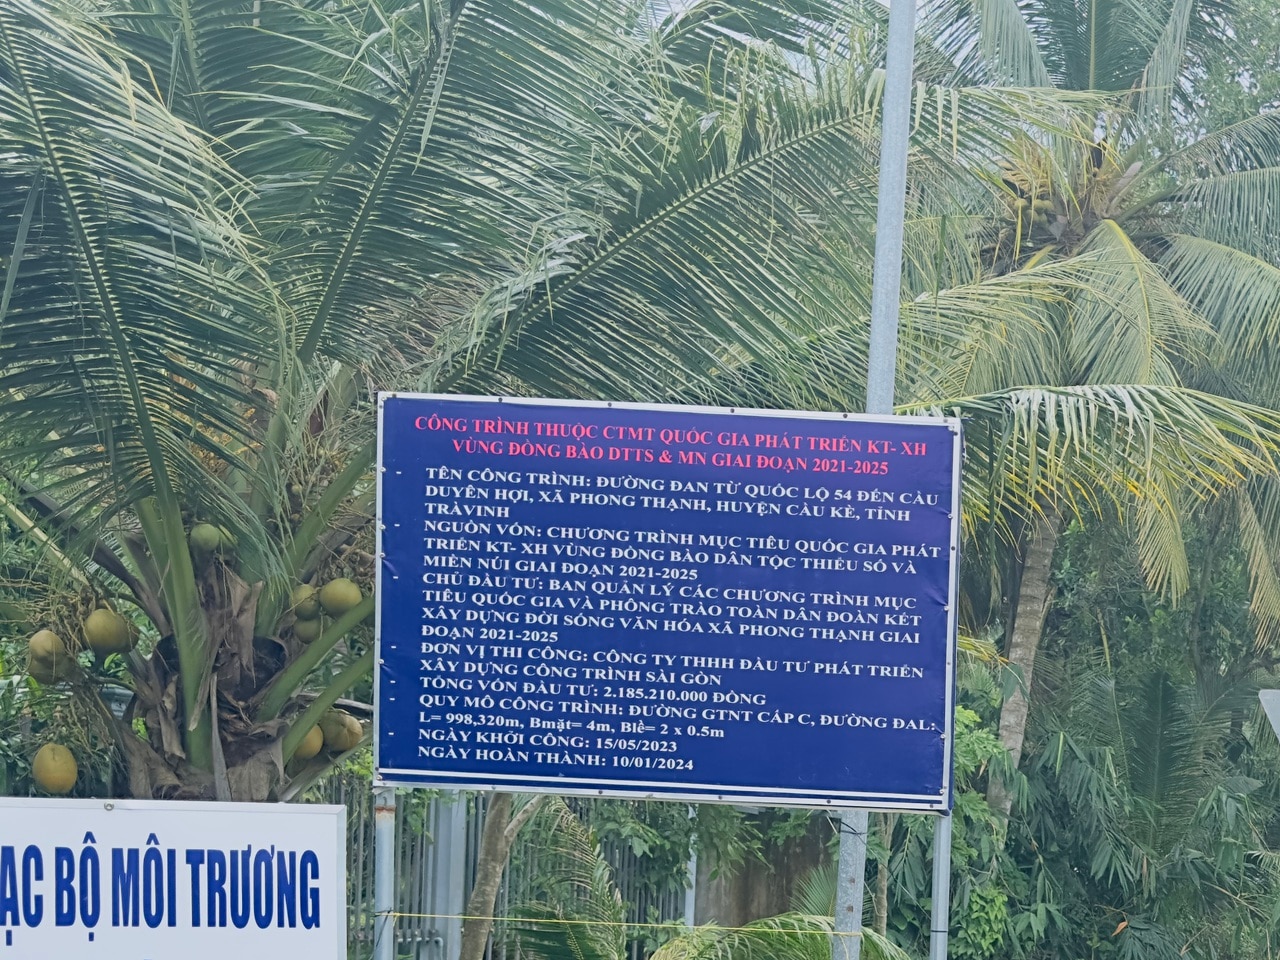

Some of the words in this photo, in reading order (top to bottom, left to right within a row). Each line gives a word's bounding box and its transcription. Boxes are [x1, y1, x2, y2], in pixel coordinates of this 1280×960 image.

[414, 413, 467, 431] CÔNG
[471, 416, 528, 434] TRÌNH
[533, 422, 597, 440] THUỘC
[602, 425, 655, 440] CTMT
[717, 432, 749, 446] GIA
[755, 431, 802, 449] PHÁT
[867, 439, 896, 453] KT-
[901, 441, 926, 455] XH
[452, 436, 502, 454] VÙNG
[565, 442, 603, 459] BÀO
[608, 446, 653, 462] DTTS
[658, 449, 672, 463] &
[678, 450, 705, 464] MN
[711, 452, 750, 467] GIAI
[756, 454, 806, 473] ĐOẠN
[812, 458, 888, 474] 2021-2025
[425, 465, 462, 480] TÊN
[467, 467, 521, 483] CÔNG
[525, 470, 590, 486] TRÌNH:
[596, 474, 664, 490] ĐƯỜNG
[670, 480, 708, 492] ĐAN
[713, 480, 741, 494] TỪ
[804, 486, 829, 501] LỘ
[834, 489, 851, 500] 54
[425, 484, 488, 498] DUYÊN
[494, 488, 533, 503] HỢI,
[538, 489, 564, 503] XÃ
[569, 492, 635, 506] PHONG
[639, 496, 711, 512] THẠNH,
[716, 500, 780, 516] HUYỆN
[830, 504, 860, 520] KÈ,
[864, 506, 910, 521] TỈNH
[486, 540, 516, 552] KT-
[521, 542, 547, 554] XH
[552, 542, 605, 557] VÙNG
[670, 548, 708, 563] BÀO
[713, 550, 752, 565] DÂN
[757, 554, 796, 569] TỘC
[891, 559, 916, 574] VÀ
[546, 526, 629, 541] CHƯƠNG
[633, 529, 693, 544] TRÌNH
[698, 534, 741, 549] MỤC
[745, 535, 789, 550] TIÊU
[853, 542, 886, 554] GIA
[891, 543, 941, 557] PHÁT
[477, 555, 509, 570] NÚI
[514, 559, 555, 572] GIAI
[561, 562, 613, 577] ĐOẠN
[619, 565, 697, 580] 2021-2025
[421, 588, 466, 603] TIÊU
[530, 595, 564, 608] GIA
[568, 595, 593, 609] VÀ
[599, 597, 664, 613] PHÔNG
[669, 601, 721, 616] TRÀO
[726, 604, 777, 618] TOÀN
[783, 606, 821, 621] DÂN
[826, 609, 878, 623] ĐOÀN
[422, 571, 462, 585] CHỦ
[511, 576, 542, 589] TƯ:
[549, 578, 586, 591] BAN
[591, 579, 644, 595] QUẢN
[650, 582, 674, 596] LÝ
[679, 583, 718, 598] CÁC
[722, 588, 805, 603] CHƯƠNG
[809, 590, 868, 606] TRÌNH
[874, 596, 916, 610] MỤC
[421, 604, 461, 619] XÂY
[465, 609, 519, 624] DỰNG
[524, 610, 558, 625] ĐỜI
[619, 615, 657, 630] VĂN
[663, 617, 704, 632] HÓA
[708, 620, 733, 634] XÃ
[739, 623, 804, 637] PHONG
[808, 627, 874, 642] THẠNH
[879, 631, 919, 643] GIAI
[421, 624, 474, 640] ĐOẠN
[479, 627, 558, 642] 2021-2025
[419, 657, 459, 671] XÂY
[464, 661, 517, 676] DỰNG
[522, 662, 576, 678] CÔNG
[581, 665, 640, 681] TRÌNH
[645, 668, 675, 683] SÀI
[680, 670, 721, 685] GÒN
[420, 641, 460, 654] ĐƠN
[465, 644, 484, 658] VỊ
[489, 645, 522, 658] THI
[527, 645, 587, 661] CÔNG:
[592, 648, 646, 664] CÔNG
[651, 653, 676, 665] TY
[782, 660, 810, 672] TƯ
[813, 660, 863, 675] PHÁT
[566, 683, 597, 696] TƯ:
[603, 686, 707, 702] 2.185.210.000
[419, 693, 459, 707] QUY
[463, 694, 494, 708] MÔ
[499, 695, 553, 711] CÔNG
[558, 699, 622, 715] TRÌNH:
[628, 703, 696, 718] ĐƯỜNG
[701, 708, 753, 721] GTNT
[797, 713, 815, 726] C,
[819, 712, 887, 728] ĐƯỜNG
[892, 717, 935, 730] ĐAL:
[419, 711, 441, 722] L=
[445, 712, 524, 729] 998,320m,
[586, 719, 615, 733] 4m,
[660, 723, 668, 734] 2
[674, 727, 681, 735] x
[686, 724, 724, 737] 0.5m
[418, 726, 471, 742] NGÀY
[476, 730, 524, 744] KHỞI
[529, 732, 589, 748] CÔNG:
[596, 737, 677, 752] 15/05/2023
[417, 744, 471, 759] NGÀY
[475, 747, 529, 762] HOÀN
[533, 750, 605, 766] THÀNH:
[612, 755, 693, 770] 10/01/2024
[54, 831, 101, 942] BỘ
[111, 833, 177, 928] MÔI
